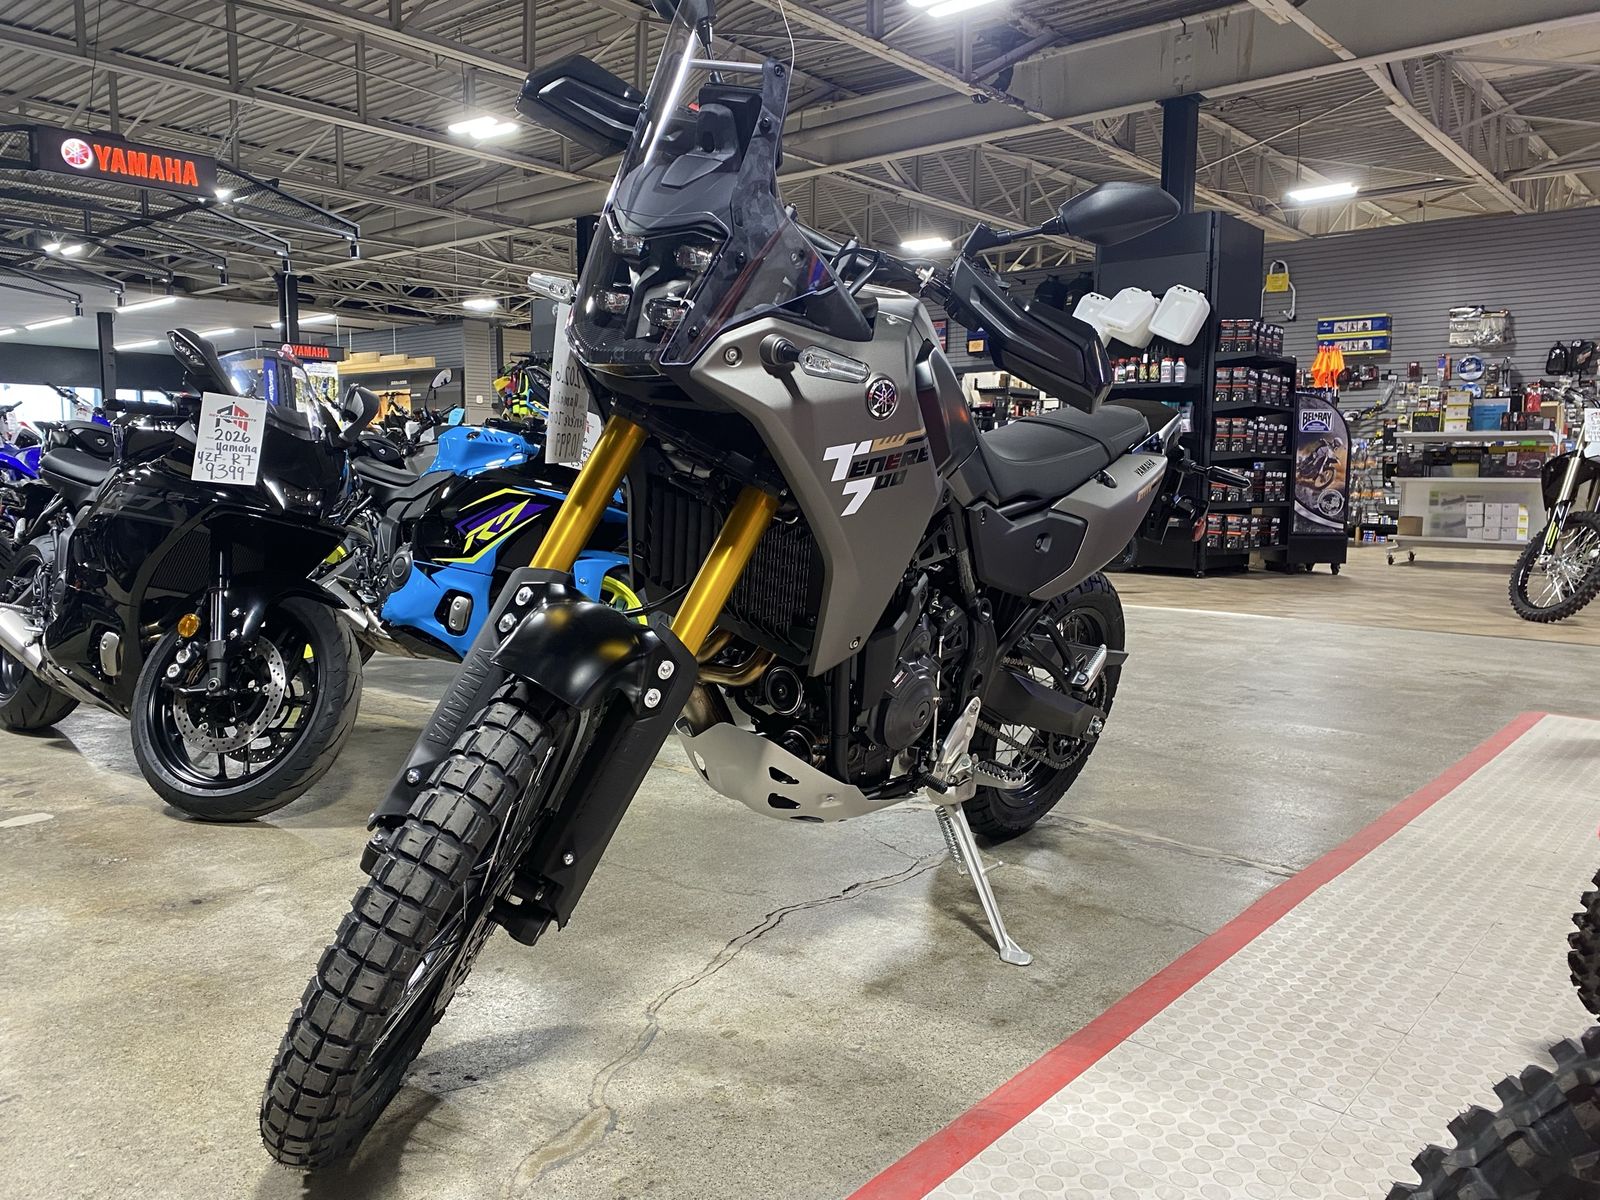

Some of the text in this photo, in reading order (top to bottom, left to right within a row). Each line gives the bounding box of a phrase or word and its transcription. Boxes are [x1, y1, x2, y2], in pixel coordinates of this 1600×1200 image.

[93, 144, 199, 187] YAMAHA
[293, 345, 329, 358] YAMAHA
[214, 428, 251, 443] 2026
[205, 462, 245, 480] 9399
[1134, 459, 1157, 477] YAMAHA
[841, 470, 908, 517] 700
[426, 647, 495, 746] YAMAHA
